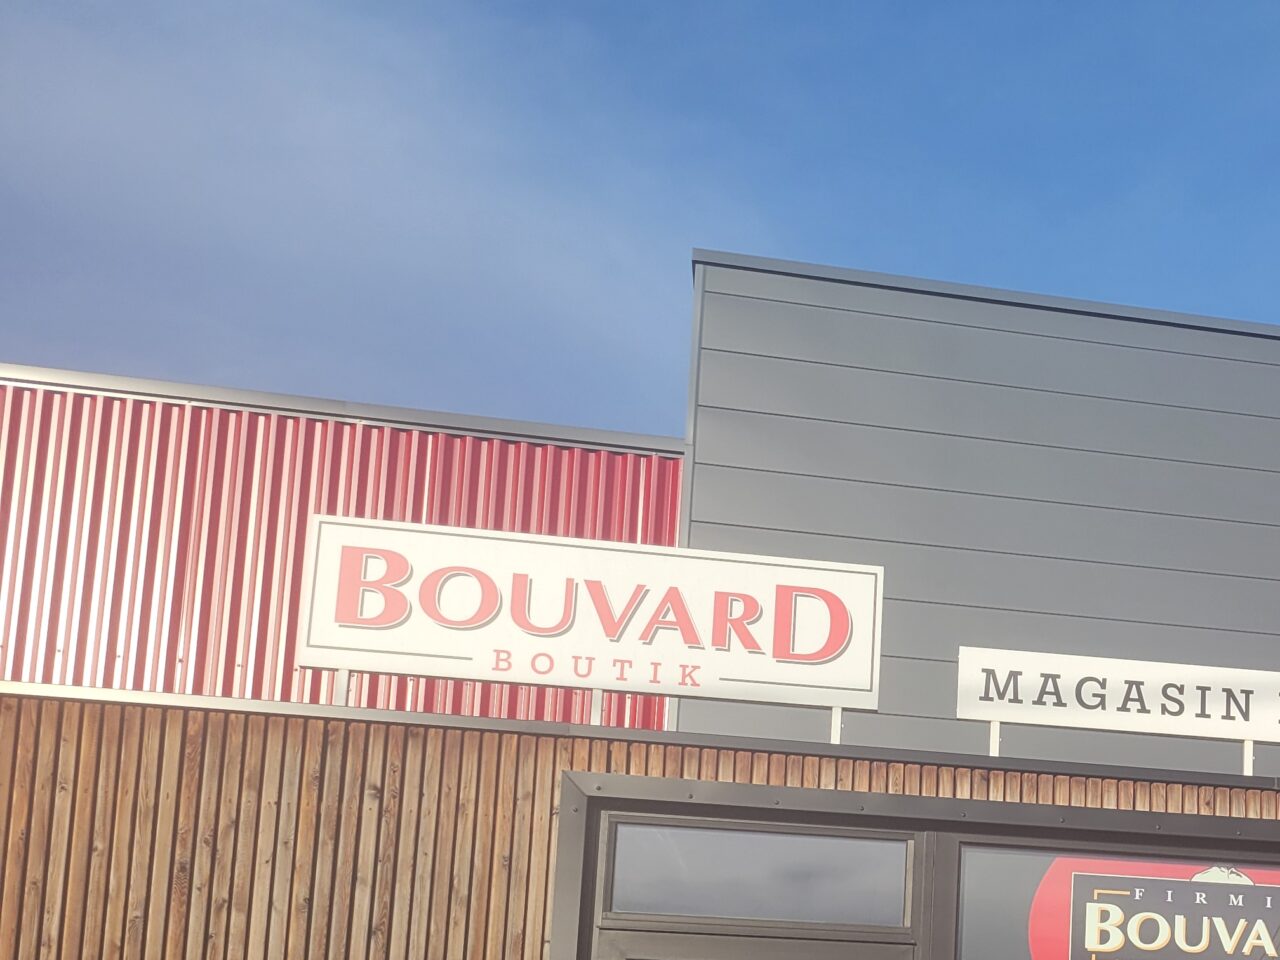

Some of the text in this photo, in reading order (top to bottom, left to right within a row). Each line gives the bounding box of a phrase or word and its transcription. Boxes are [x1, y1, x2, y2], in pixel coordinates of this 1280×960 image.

[334, 546, 853, 665] BOUVARD
[492, 649, 702, 687] BOUTIK
[978, 668, 1254, 722] MAGASIN
